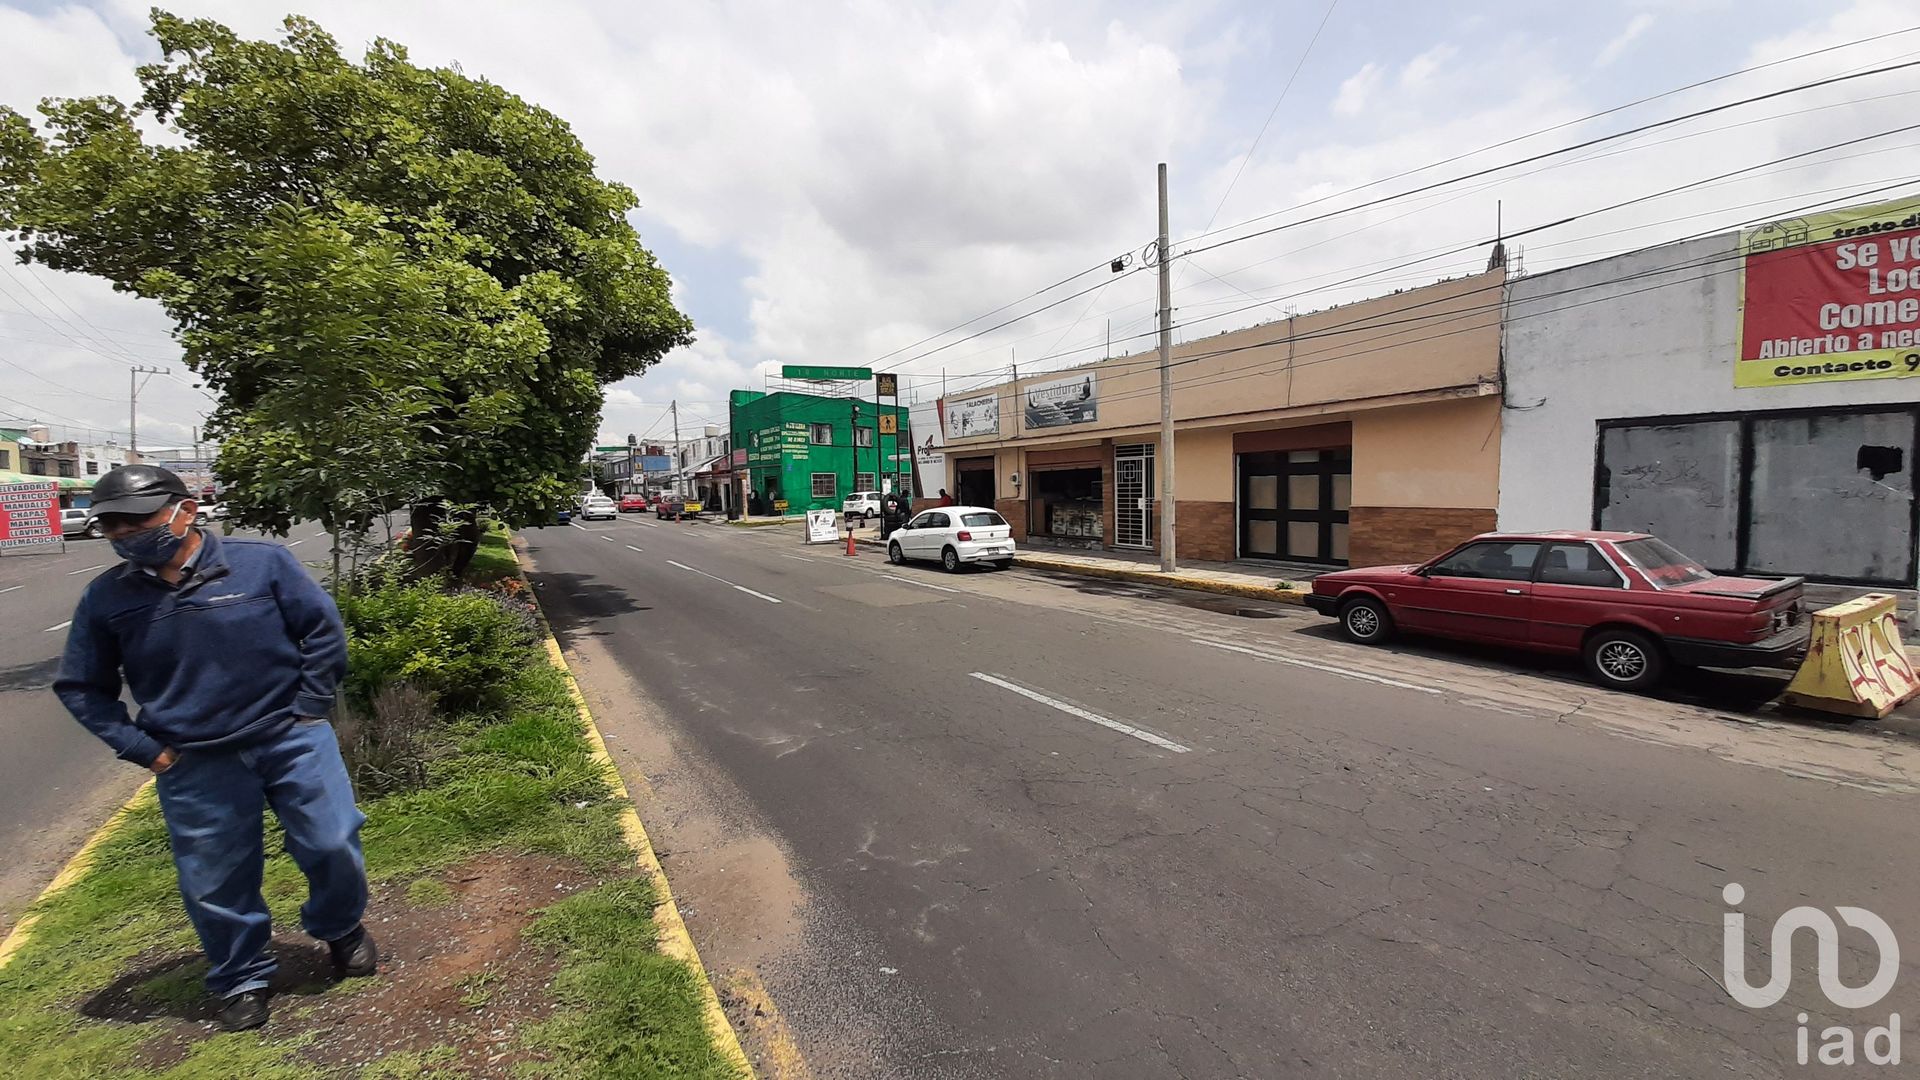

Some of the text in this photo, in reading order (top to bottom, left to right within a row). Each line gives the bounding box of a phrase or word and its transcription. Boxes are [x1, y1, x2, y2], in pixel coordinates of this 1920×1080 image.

[1833, 222, 1896, 238] trato
[1836, 242, 1878, 270] Se
[1820, 298, 1919, 331] Come
[1759, 334, 1850, 360] Abierto
[1858, 332, 1873, 350] a
[1774, 359, 1893, 377] Contacto
[4, 501, 51, 510] MANUALES
[11, 510, 46, 519] CHAPAS
[10, 519, 48, 527] MANIJAS
[1, 536, 62, 546] QUEMACOCOS
